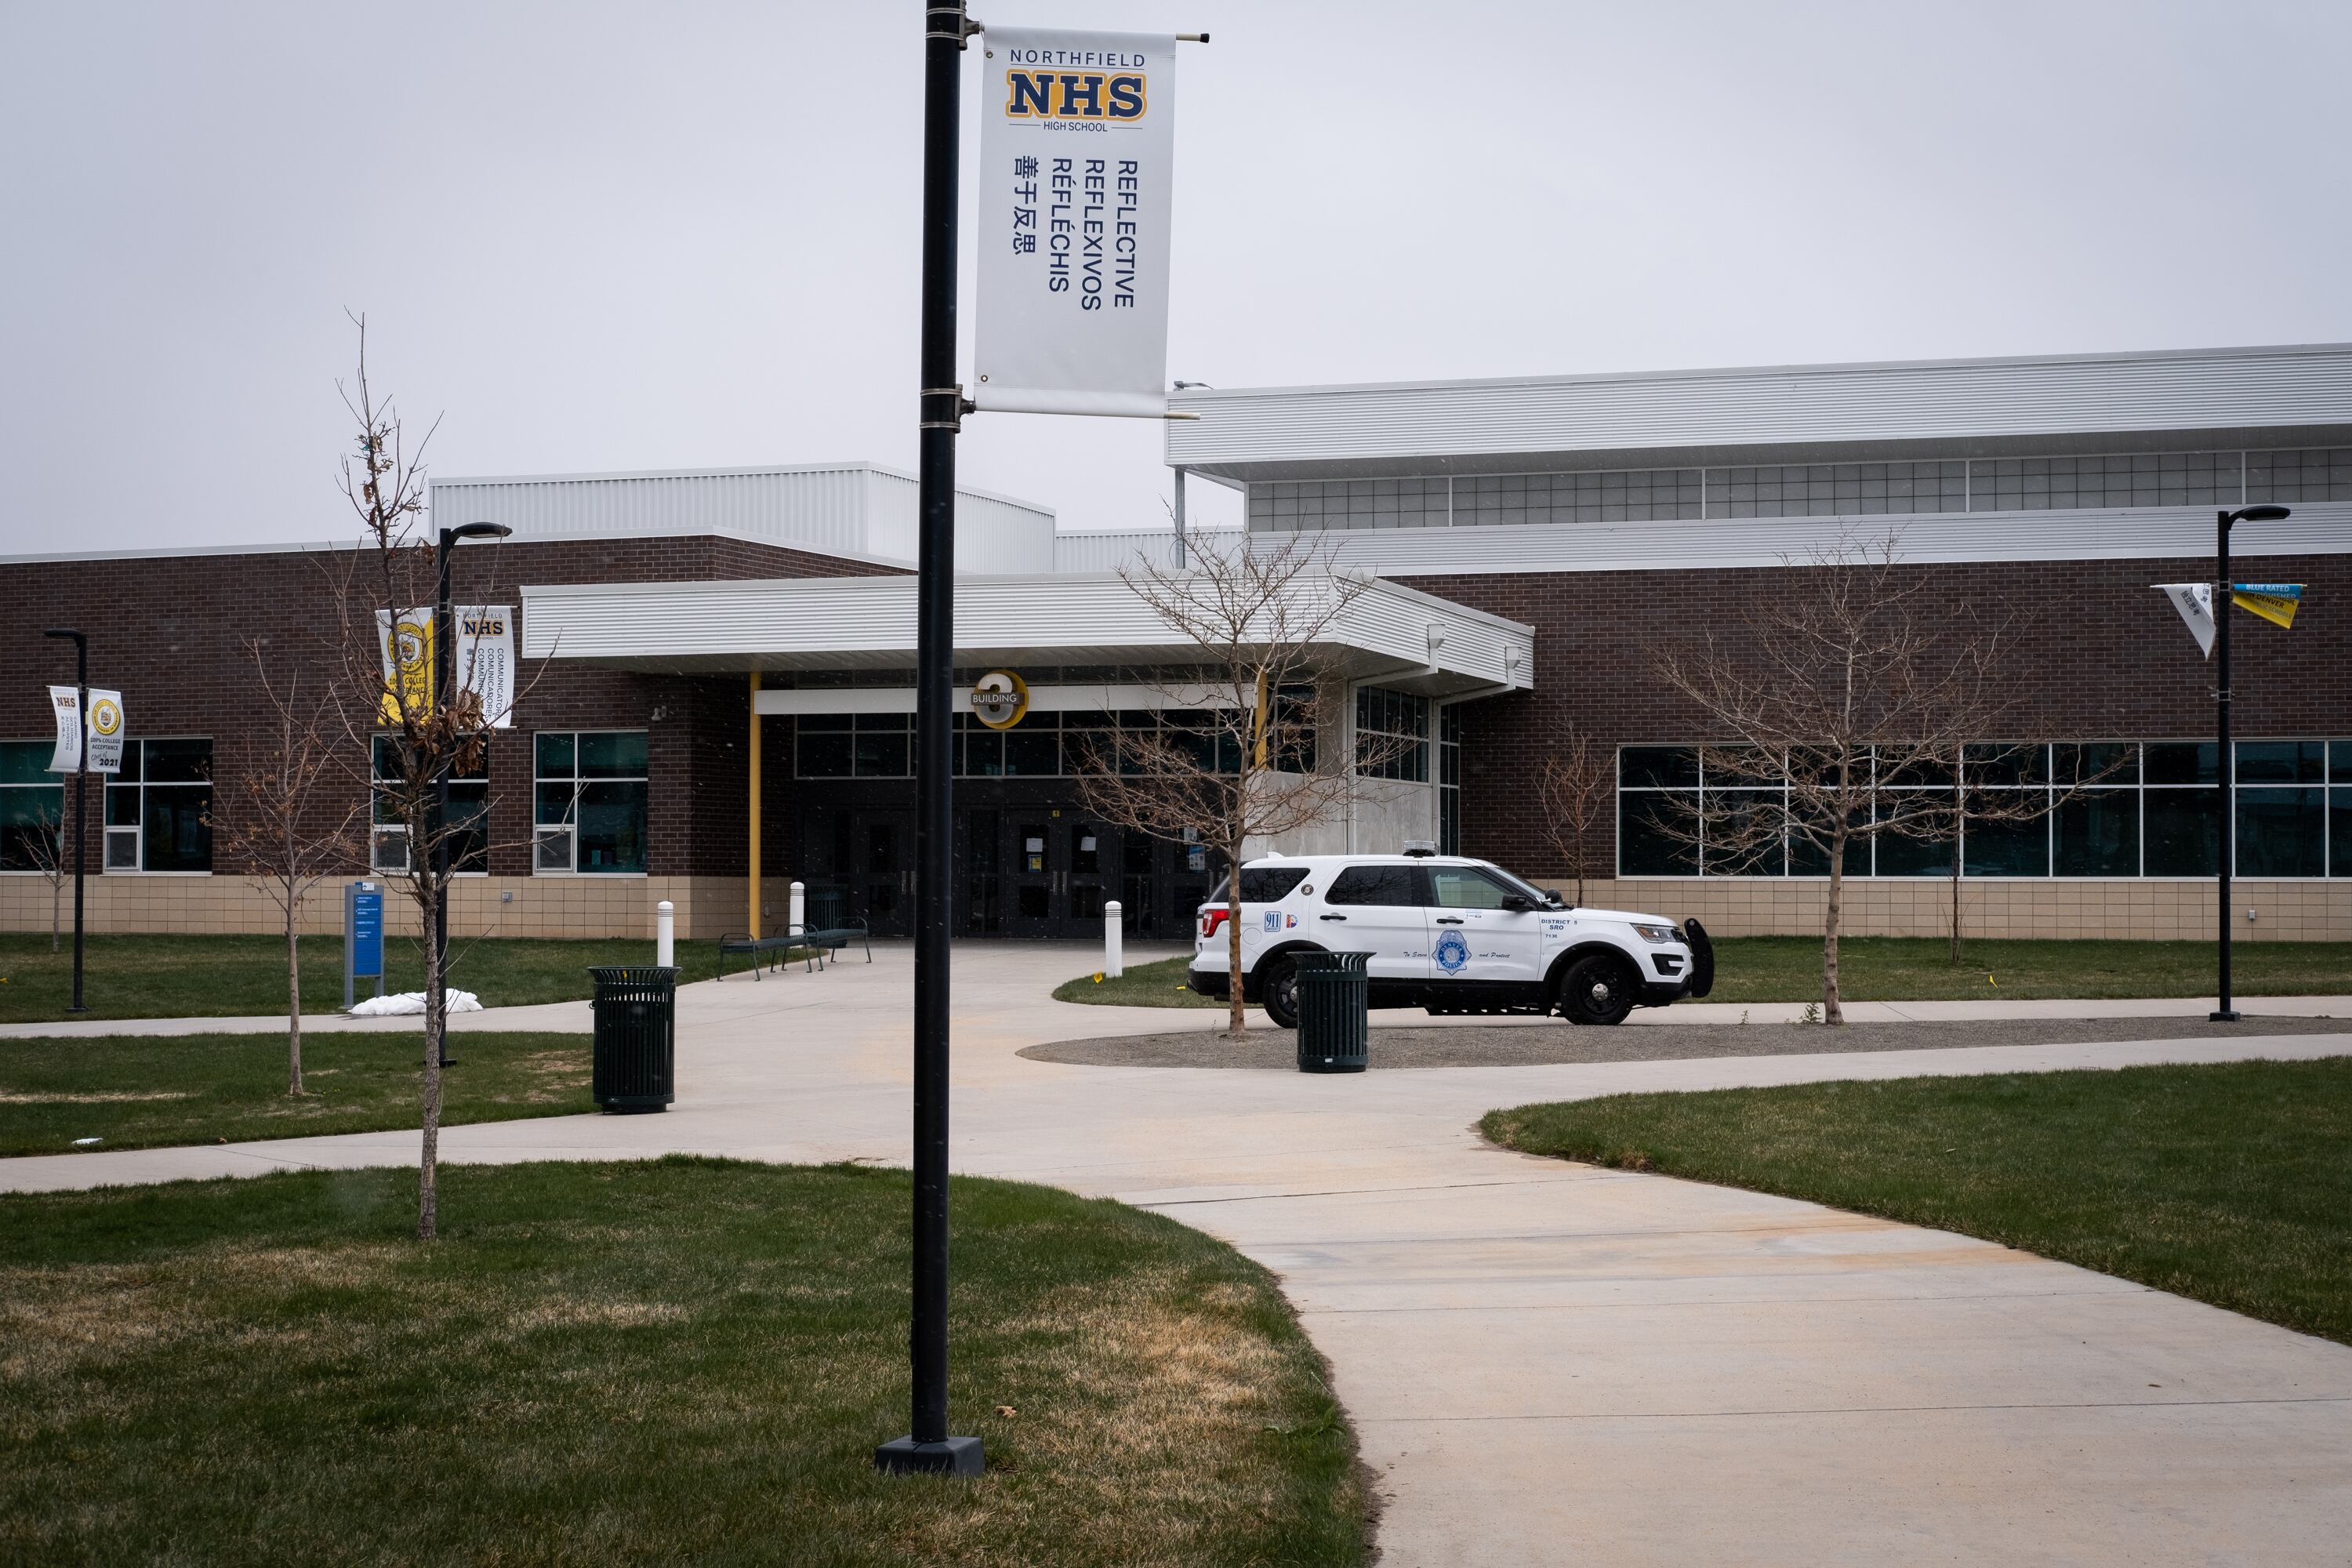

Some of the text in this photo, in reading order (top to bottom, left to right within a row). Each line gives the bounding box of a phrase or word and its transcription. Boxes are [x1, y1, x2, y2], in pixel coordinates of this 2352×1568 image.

[1010, 49, 1145, 67] NORTHFIELD
[1008, 72, 1145, 118] NHS
[1044, 121, 1108, 132] HIGH SCHOOL
[1012, 155, 1039, 256] 善于反思
[1049, 158, 1077, 293] RÉFLÉCHIS
[1081, 159, 1105, 311] REFLEXIVOS
[1114, 160, 1138, 309] REFLECTIVE
[2256, 593, 2285, 608] DENVER
[463, 621, 503, 635] NHS
[486, 648, 495, 720] COMUNICADORES
[56, 697, 76, 707] NHS
[972, 694, 1017, 703] BUILDING
[99, 758, 118, 767] 2021
[1266, 913, 1279, 927] 911
[1441, 942, 1463, 952] DENVER
[1442, 960, 1463, 969] POLICE
